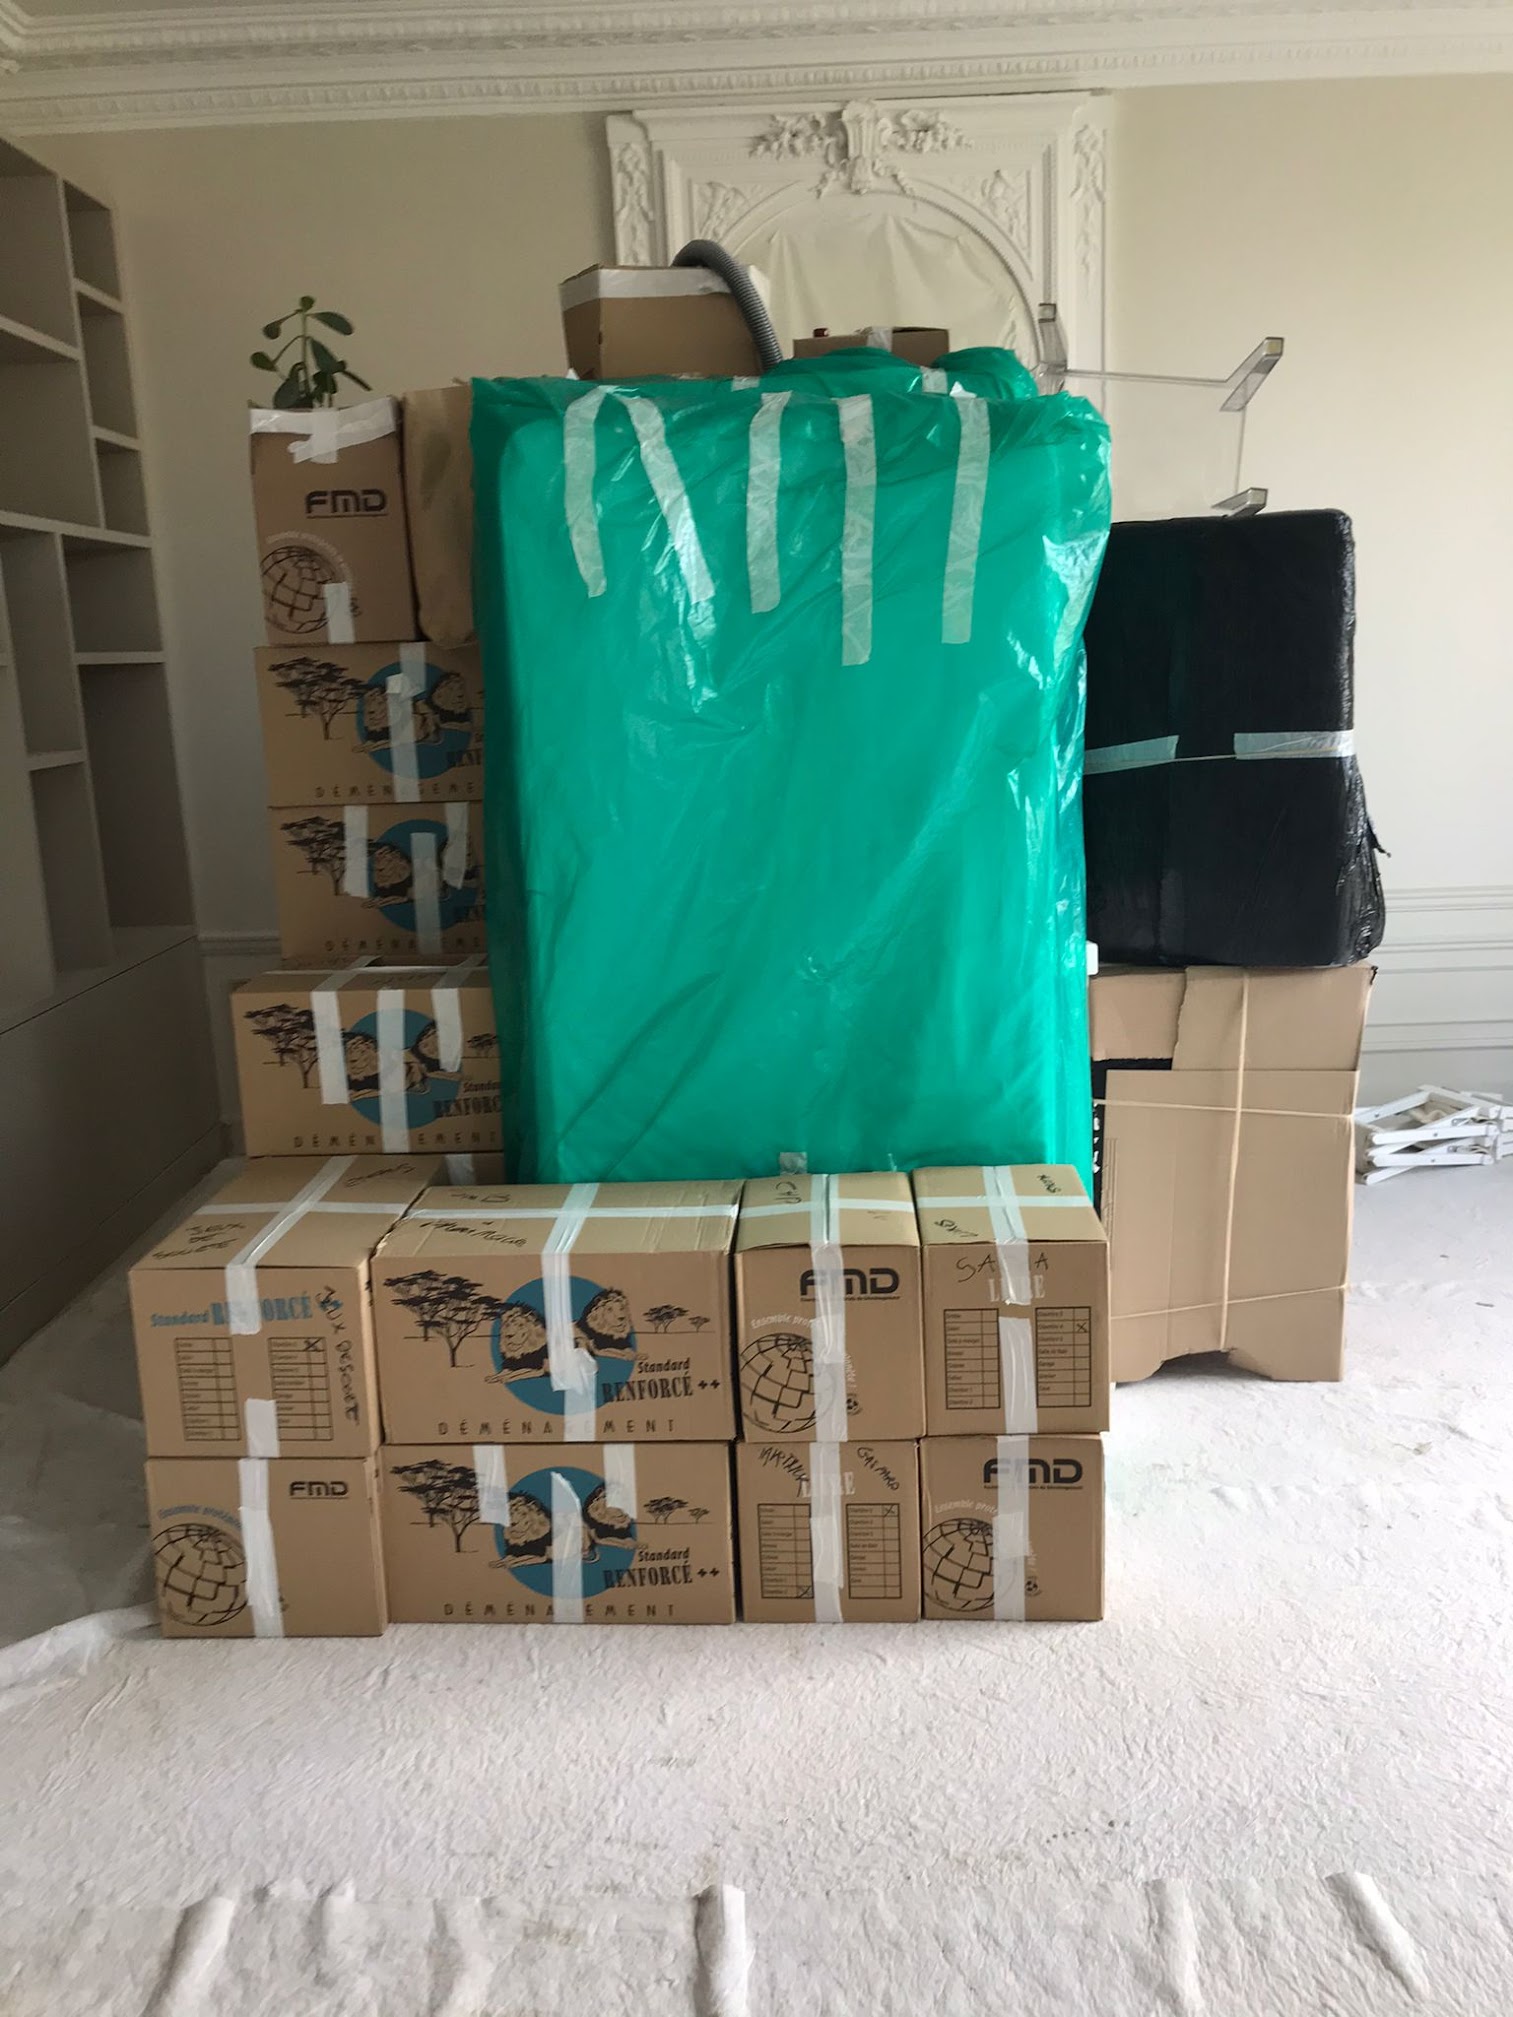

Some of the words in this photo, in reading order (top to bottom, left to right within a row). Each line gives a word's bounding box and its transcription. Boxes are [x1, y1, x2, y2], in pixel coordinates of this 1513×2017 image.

[304, 489, 388, 514] FMD
[638, 1357, 690, 1374] Standard
[602, 1371, 693, 1402] RENFORCÉ
[438, 1419, 675, 1435] DÉMÉNAEMENT
[983, 1458, 1083, 1485] FMD
[290, 1480, 348, 1496] FMD
[638, 1547, 690, 1562] Standard
[603, 1560, 693, 1589] RENFORCÉ
[444, 1601, 675, 1618] DÉMÉNAEMENT
